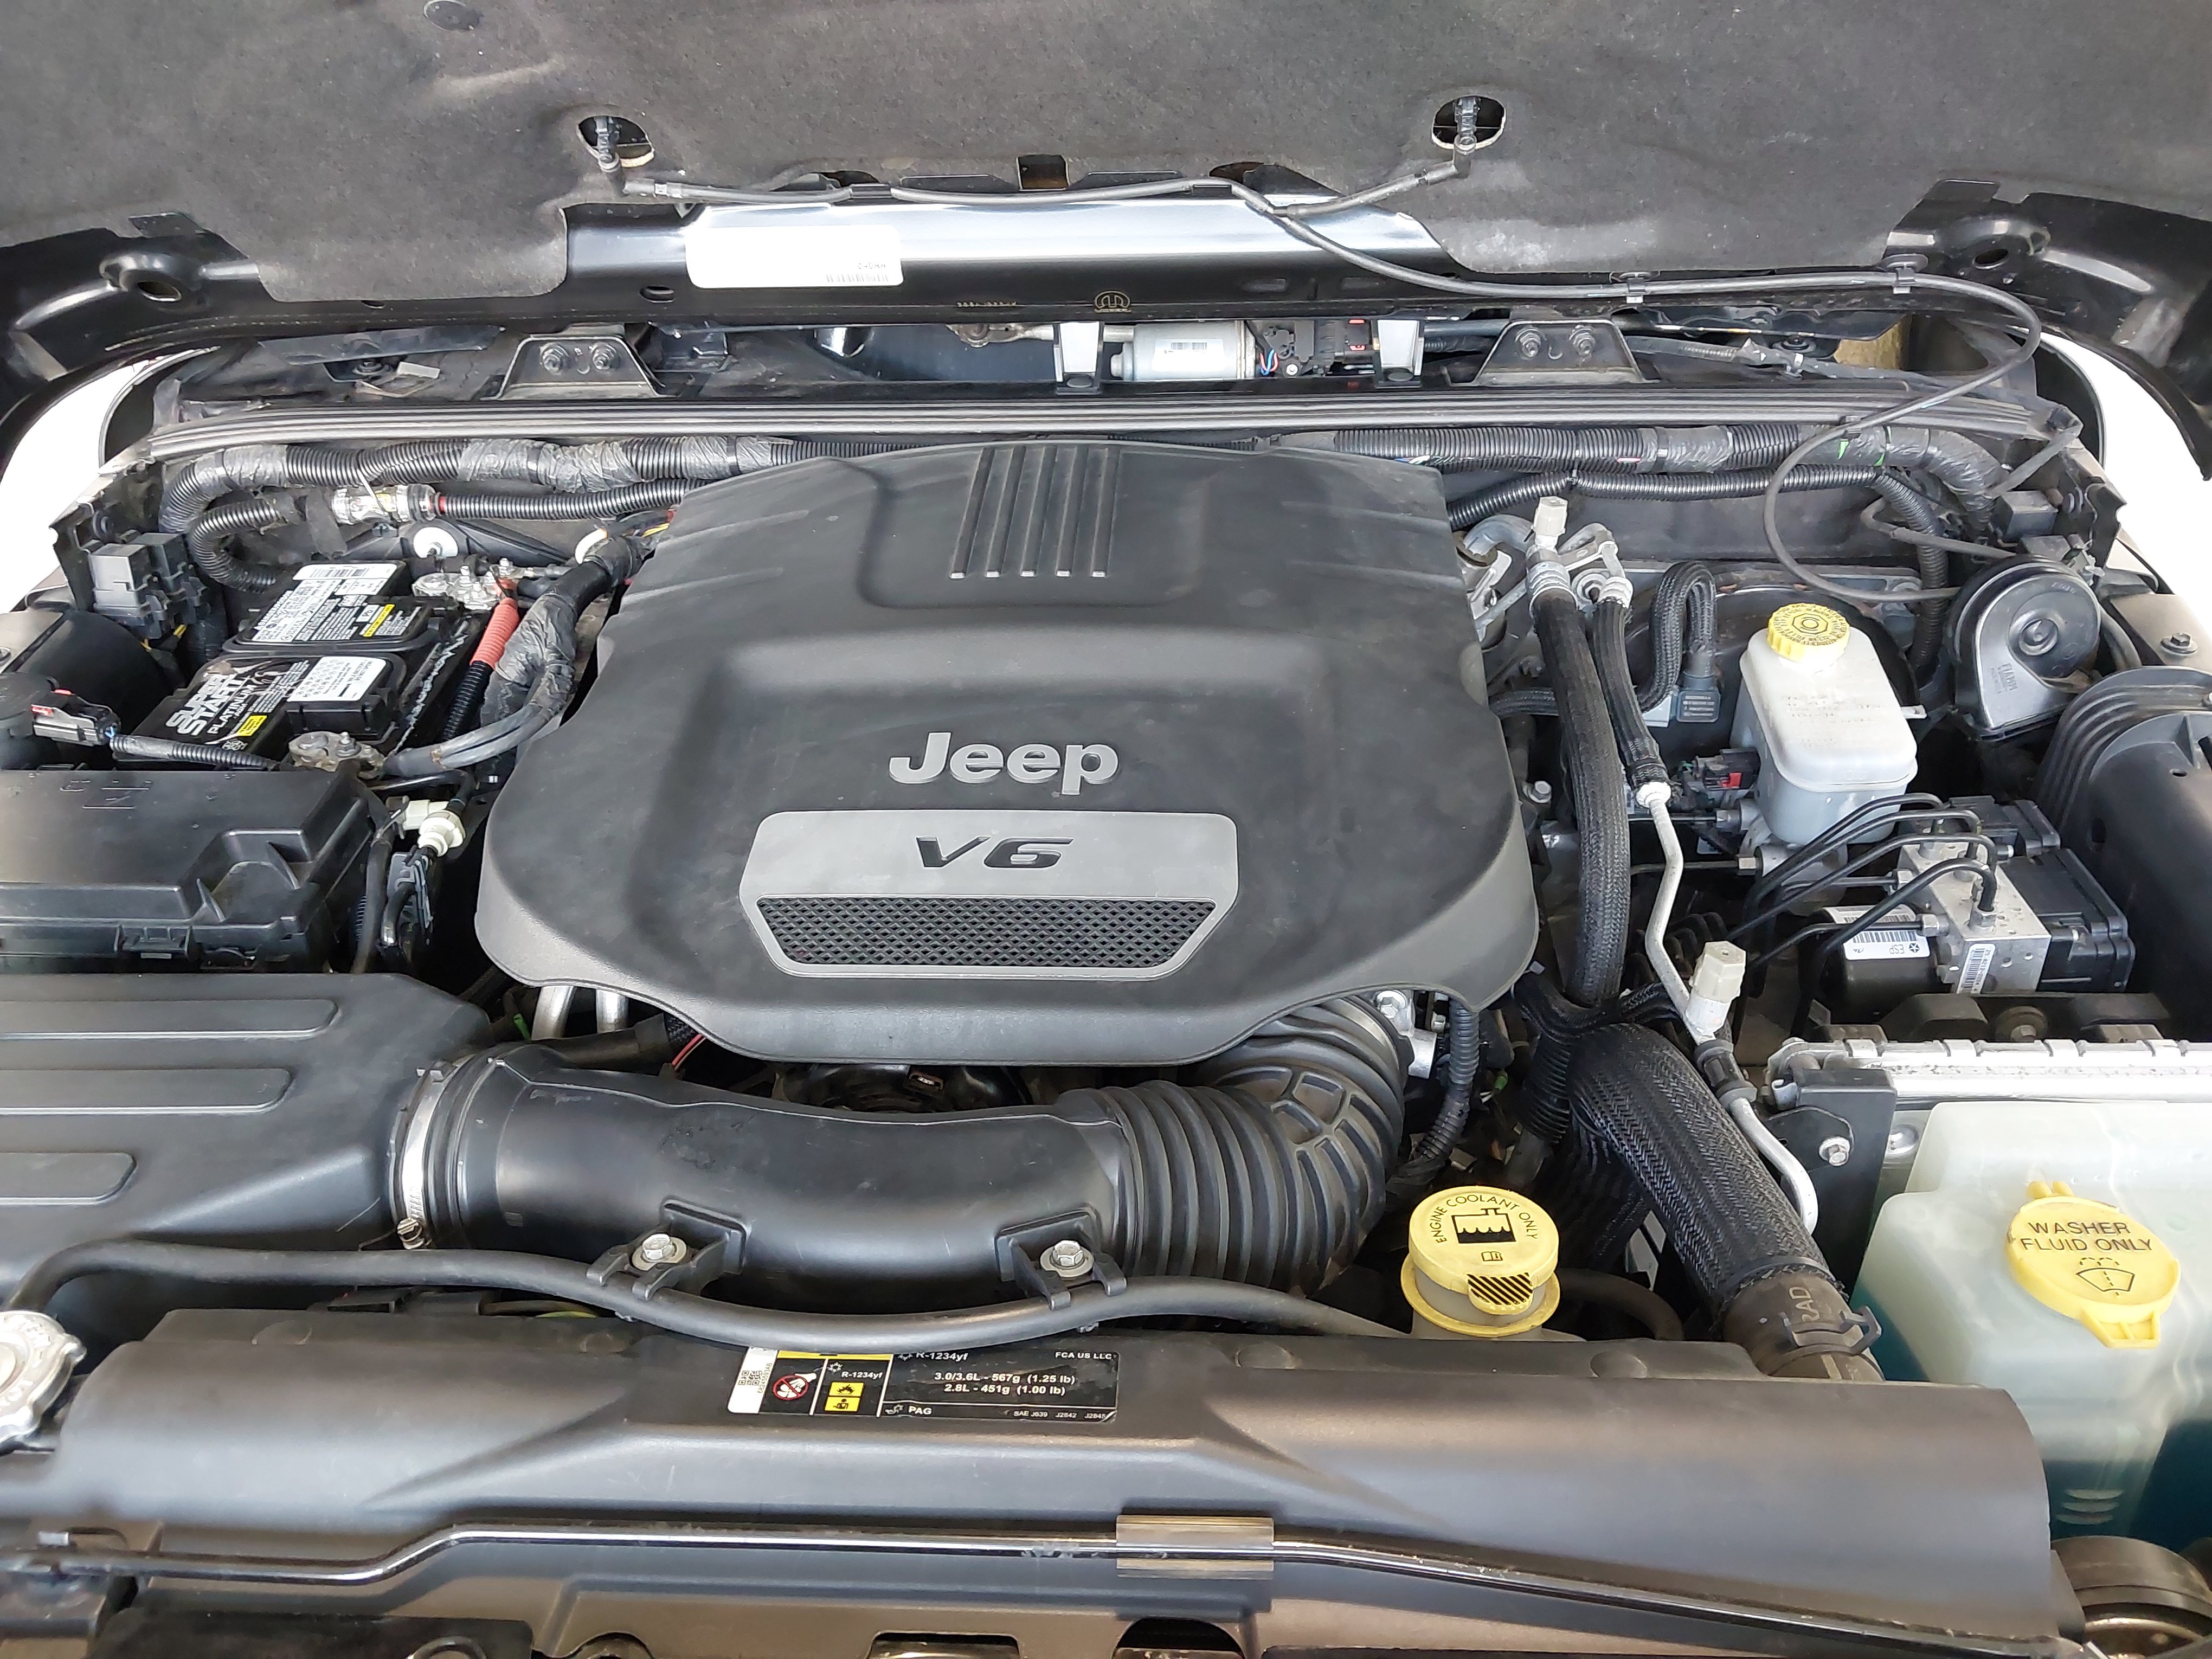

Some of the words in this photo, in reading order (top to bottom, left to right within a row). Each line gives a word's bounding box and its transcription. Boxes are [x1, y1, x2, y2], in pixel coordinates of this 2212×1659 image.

[165, 674, 227, 727] SUPER
[177, 673, 244, 736] START
[207, 685, 257, 734] PLATINUM
[889, 732, 1118, 795] Jeep
[916, 836, 1074, 868] V6
[1430, 1206, 1448, 1244] ENGINE
[1446, 1194, 1520, 1211] COOLANT
[1519, 1212, 1538, 1240] ONLY
[2028, 1221, 2131, 1235] WASHER
[2021, 1238, 2087, 1251] FLUID
[2094, 1238, 2153, 1251] ONLY
[841, 1371, 884, 1379] R-1234yf
[934, 1372, 981, 1381] 3.0/3.6L
[992, 1373, 1020, 1383] 567g
[1027, 1374, 1057, 1384] (1.25
[1059, 1375, 1076, 1385] lb)
[944, 1384, 970, 1392] 2.8L
[981, 1385, 1010, 1395] 451g
[1017, 1385, 1046, 1396] (1.00
[1050, 1386, 1065, 1396] lb)
[908, 1405, 932, 1415] PAG
